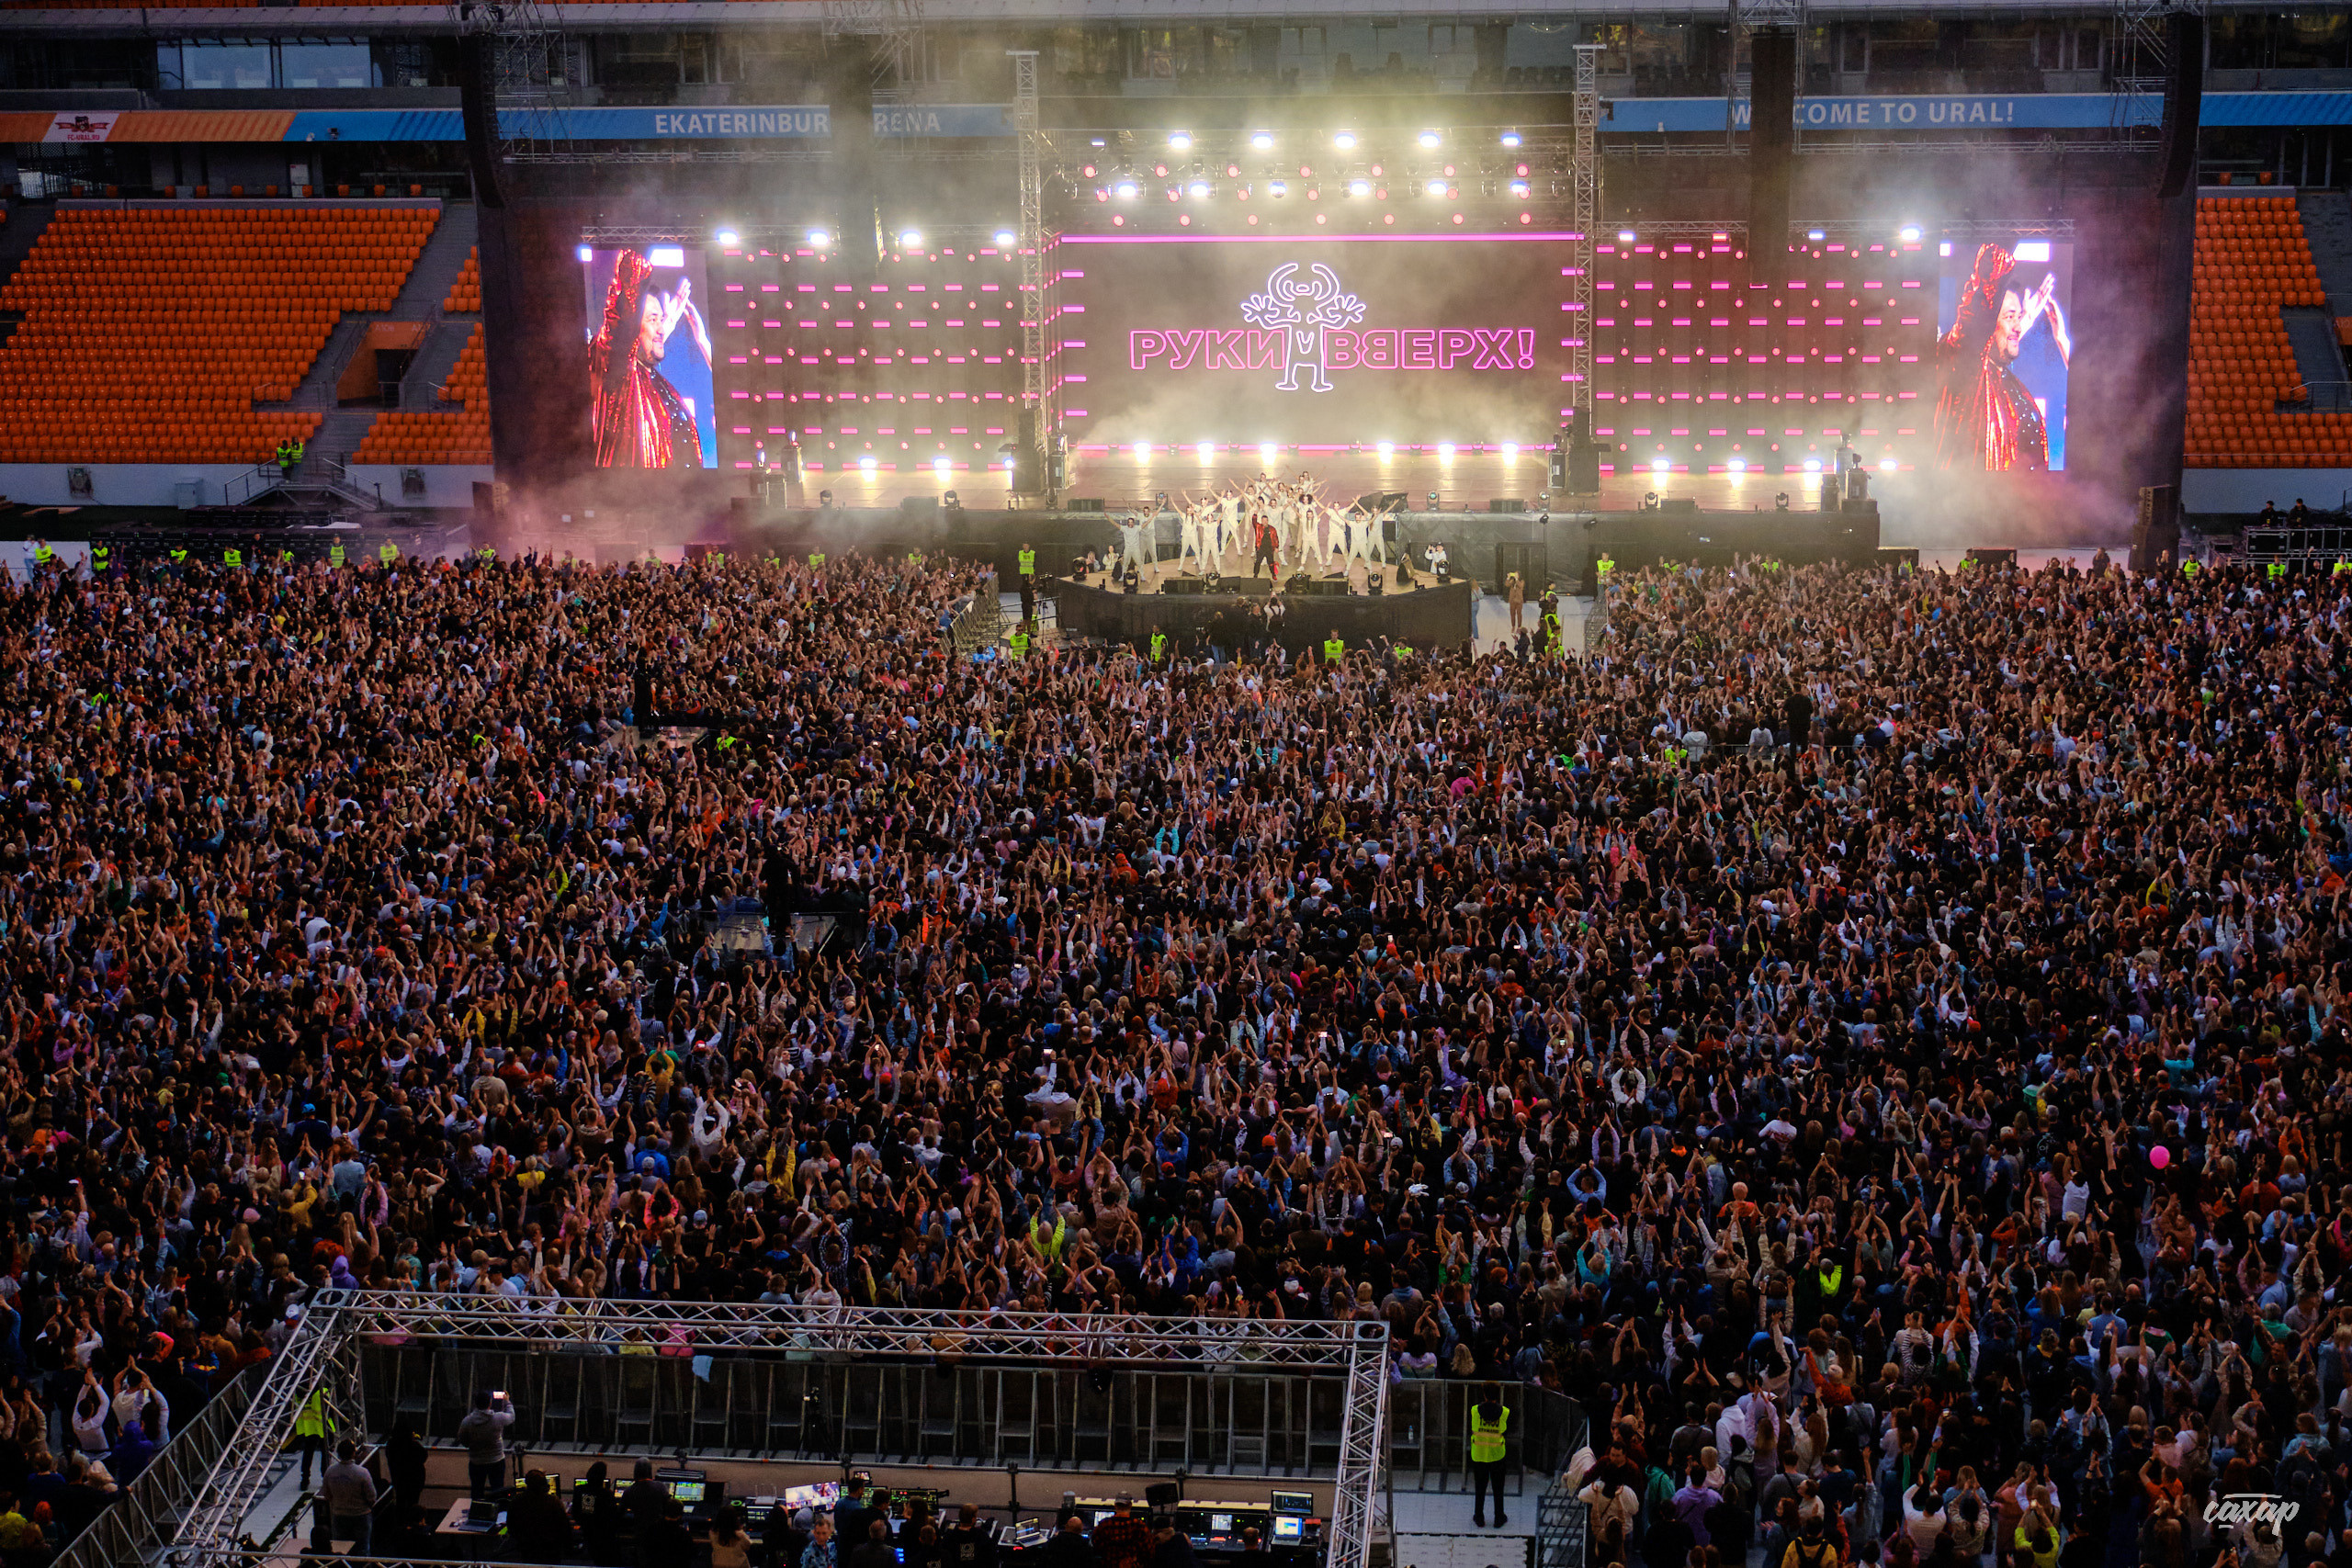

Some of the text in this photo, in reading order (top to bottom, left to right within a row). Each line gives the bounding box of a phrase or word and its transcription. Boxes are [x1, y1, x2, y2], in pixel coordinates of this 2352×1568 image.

[654, 111, 942, 135] EKATERINBUR RENA
[1731, 101, 2014, 125] WCOME TO URAL!
[1129, 329, 1536, 370] РУКИ ВВЕРХ!
